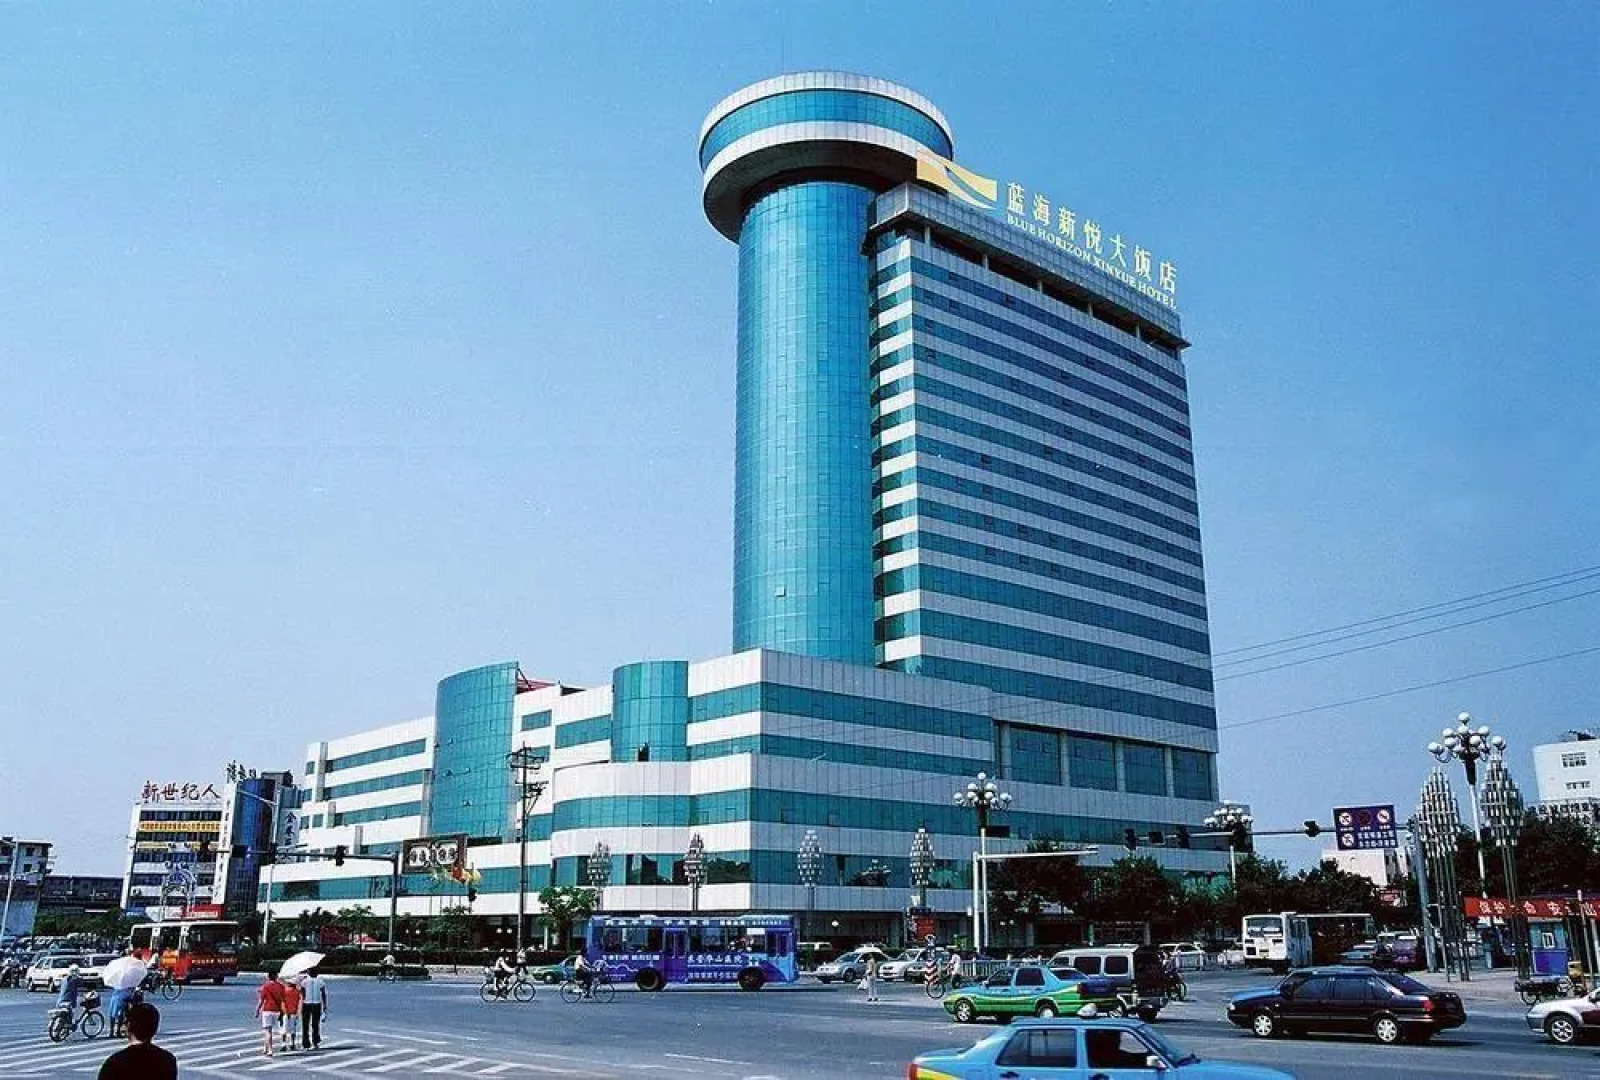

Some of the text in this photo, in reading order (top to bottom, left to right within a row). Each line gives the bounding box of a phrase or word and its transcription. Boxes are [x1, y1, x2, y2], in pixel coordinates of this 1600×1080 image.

[1007, 181, 1178, 294] 蓝海新悦大饭店
[1007, 213, 1177, 310] BLUE HORIZON XINYUE HOTEL
[141, 780, 221, 803] 新世纪人
